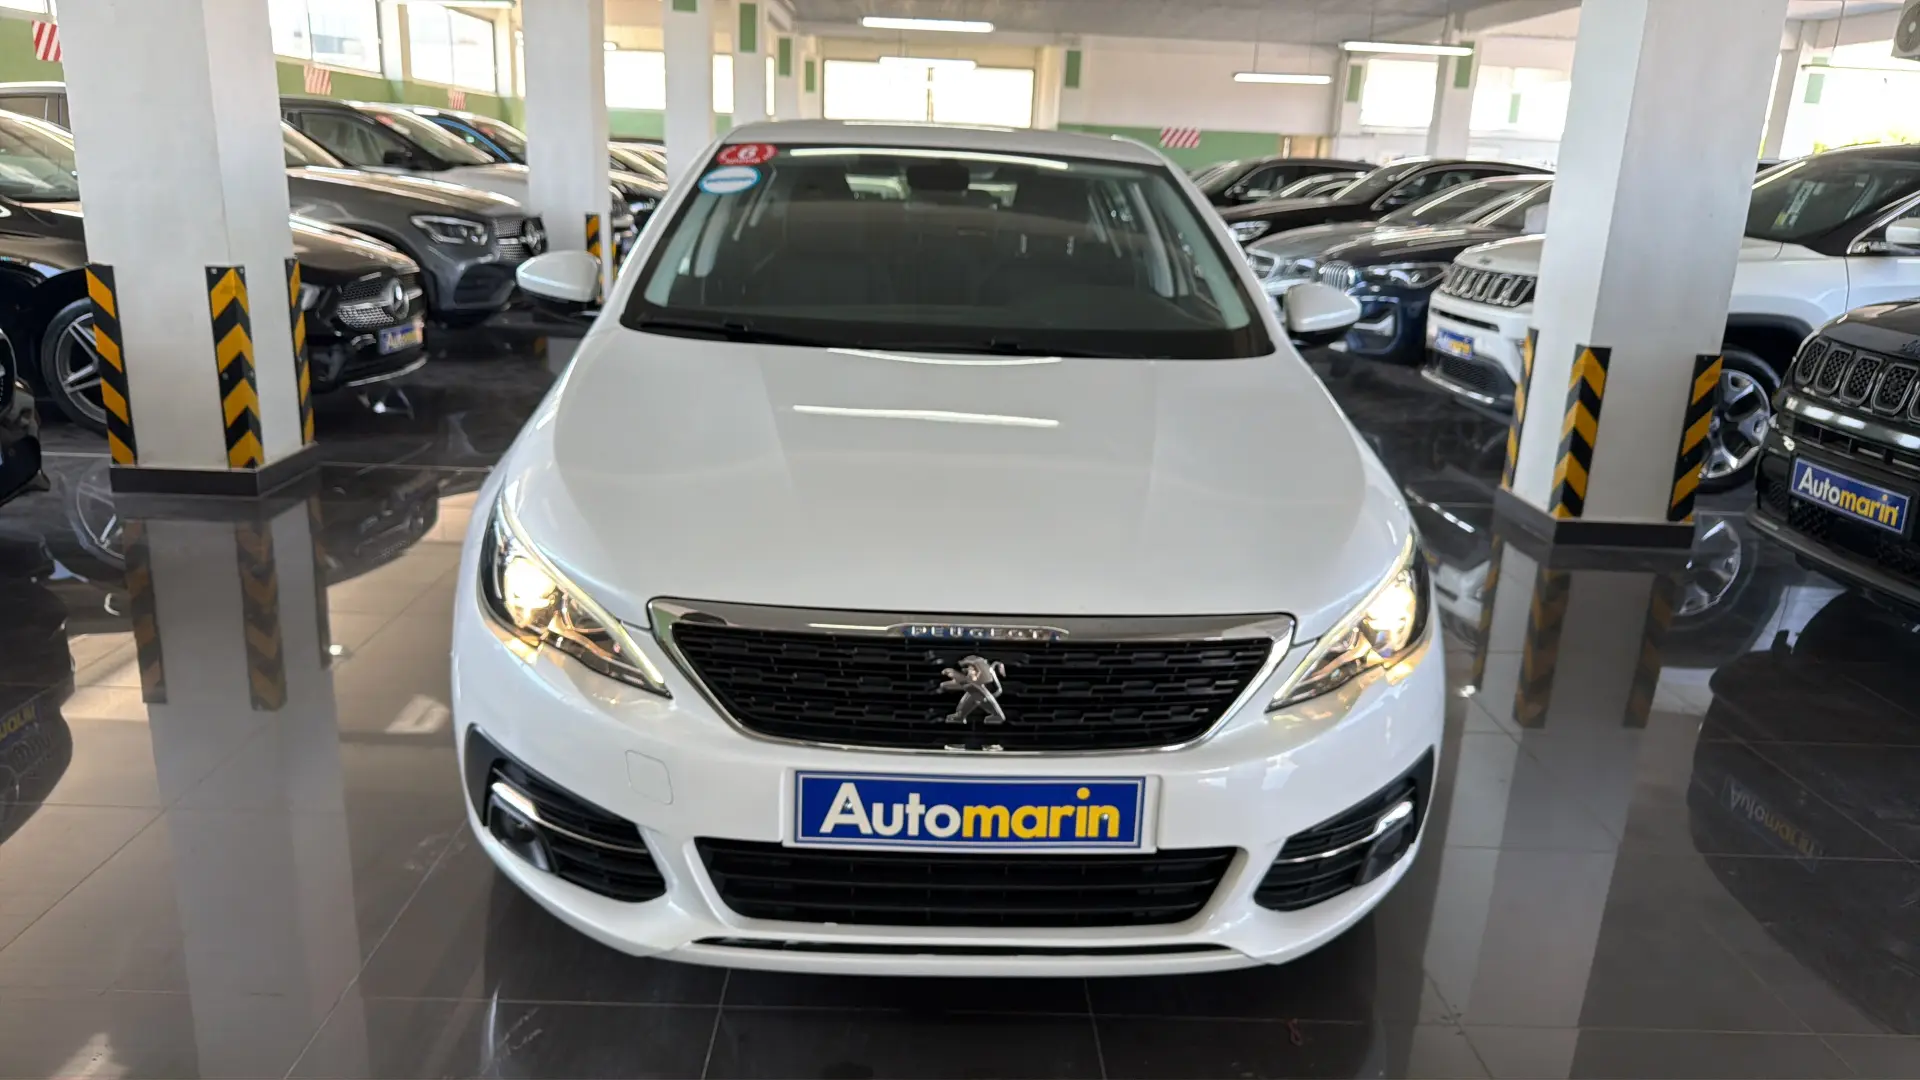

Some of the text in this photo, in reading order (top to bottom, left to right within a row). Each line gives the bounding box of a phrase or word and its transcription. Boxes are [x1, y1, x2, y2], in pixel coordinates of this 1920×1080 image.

[1797, 466, 1900, 527] Automarin
[911, 625, 1045, 640] PEUGEOT
[819, 782, 1120, 839] Automarin
